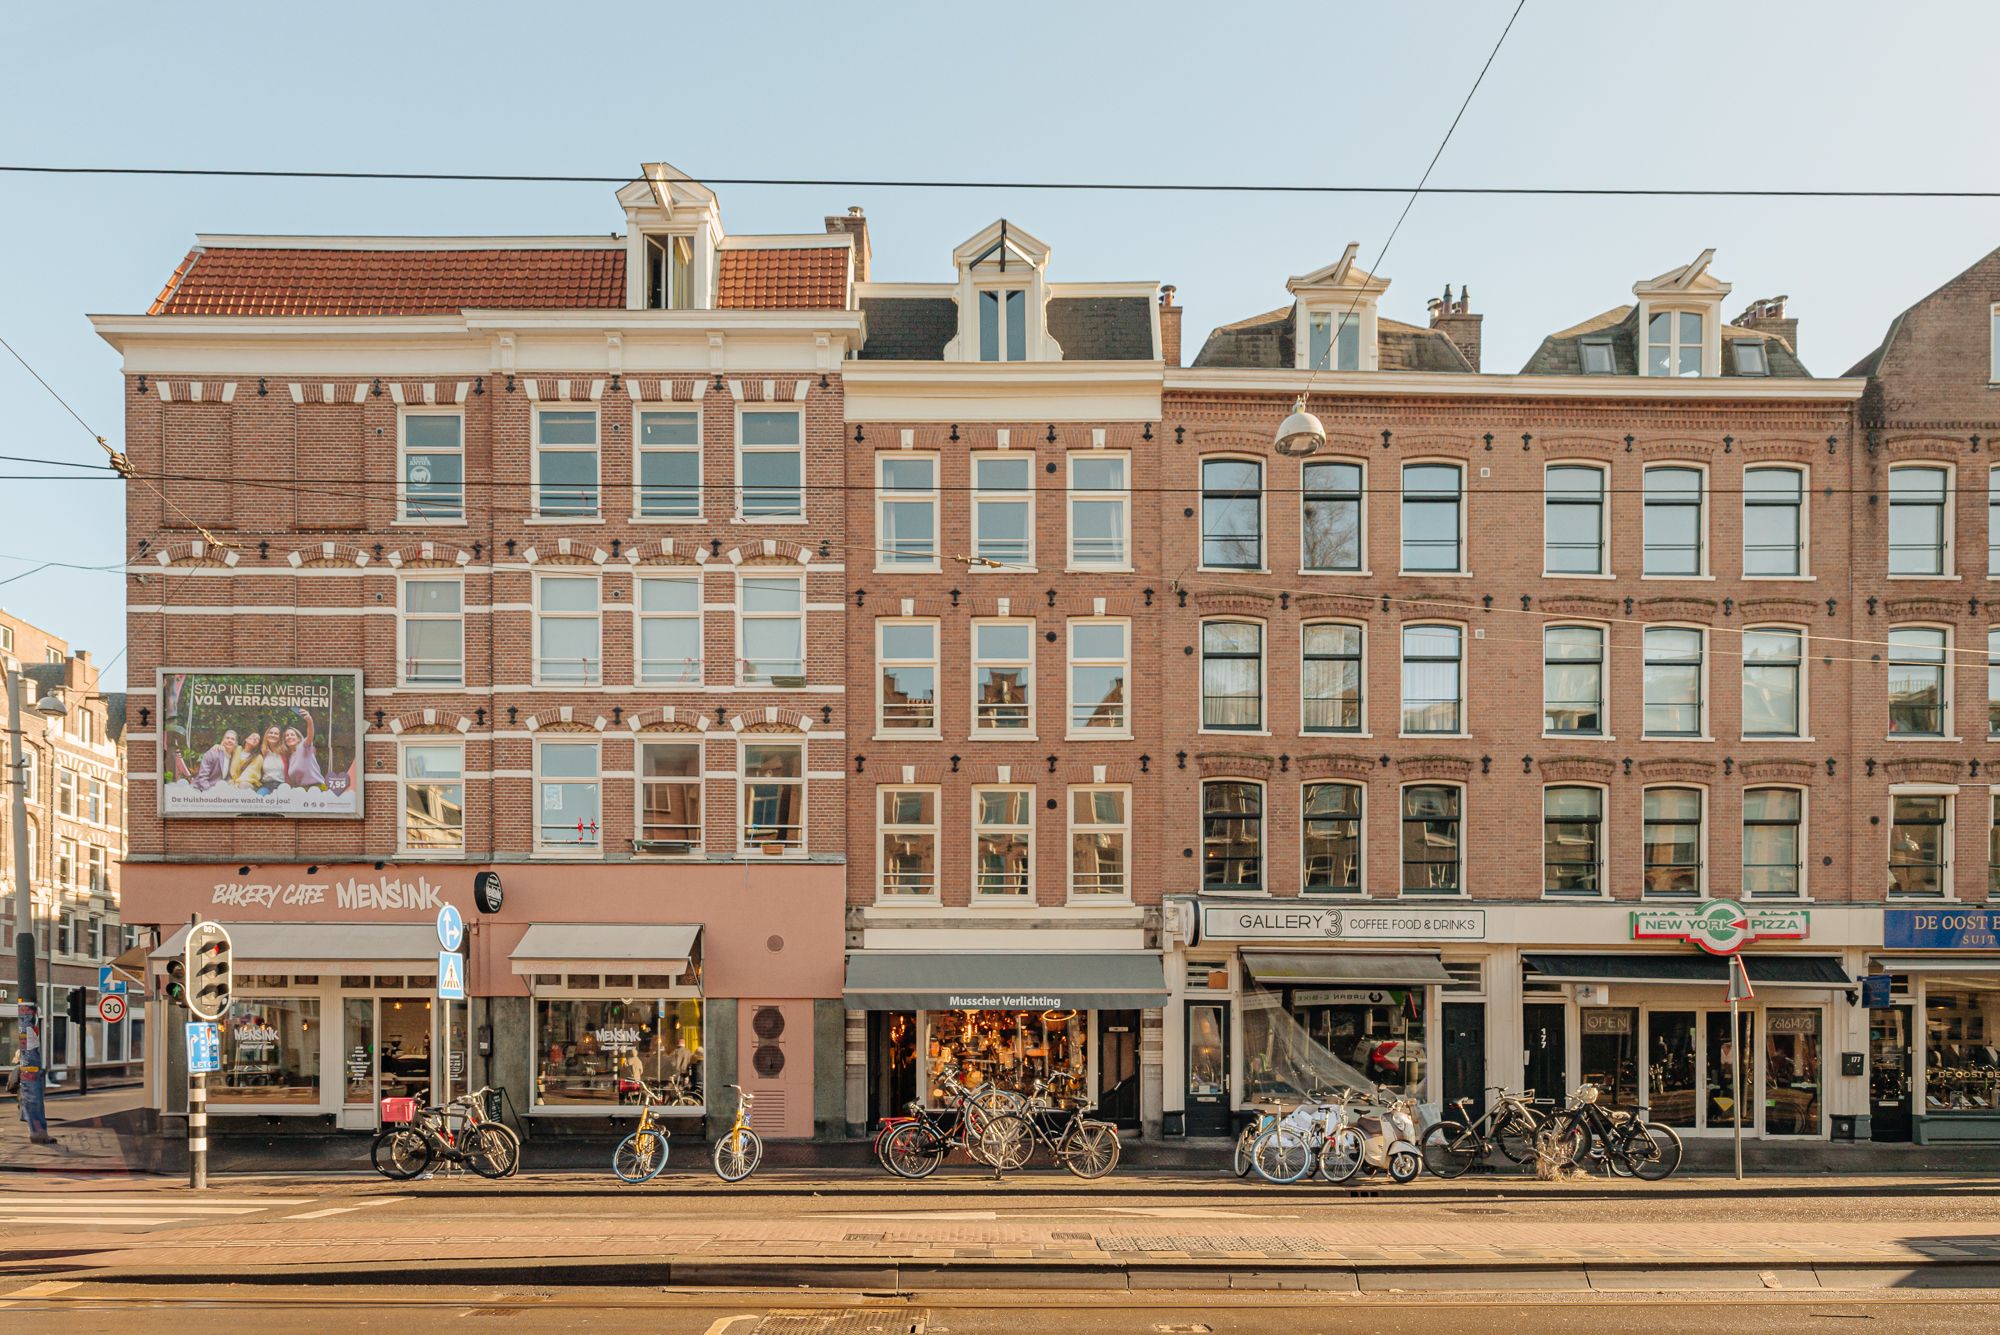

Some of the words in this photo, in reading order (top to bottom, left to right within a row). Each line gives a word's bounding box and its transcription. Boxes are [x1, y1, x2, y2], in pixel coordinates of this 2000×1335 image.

[194, 684, 226, 695] STAP
[230, 684, 241, 694] IN
[246, 684, 271, 695] EEN
[275, 685, 328, 696] WERELD
[194, 695, 221, 706] VOL
[225, 696, 328, 708] VERRASSINGEN
[328, 780, 346, 789] 7,95
[183, 796, 239, 804] Huishoudbeurs
[240, 796, 264, 804] wacht
[211, 883, 282, 909] BAKERY
[282, 883, 329, 905] CAFE
[335, 875, 444, 911] MENSINK
[1239, 914, 1323, 929] GALLERY
[1324, 909, 1342, 938] 3
[1392, 918, 1421, 930] FOOD
[1424, 919, 1431, 930] &
[1434, 919, 1475, 930] DRINKS
[1645, 919, 1682, 930] NEW
[1686, 918, 1737, 932] YORK
[1752, 919, 1799, 930] PIZZA
[1914, 915, 1938, 930] DE
[1942, 915, 1988, 930] OOST
[104, 1003, 121, 1014] 30
[949, 996, 1001, 1006] Musscher
[1002, 996, 1061, 1008] Verlichting
[1587, 1016, 1627, 1028] OPEN
[234, 1026, 280, 1041] MENSINK
[595, 1027, 642, 1042] MENSINK
[1540, 1027, 1548, 1049] 177
[1955, 1070, 1984, 1078] OOST
